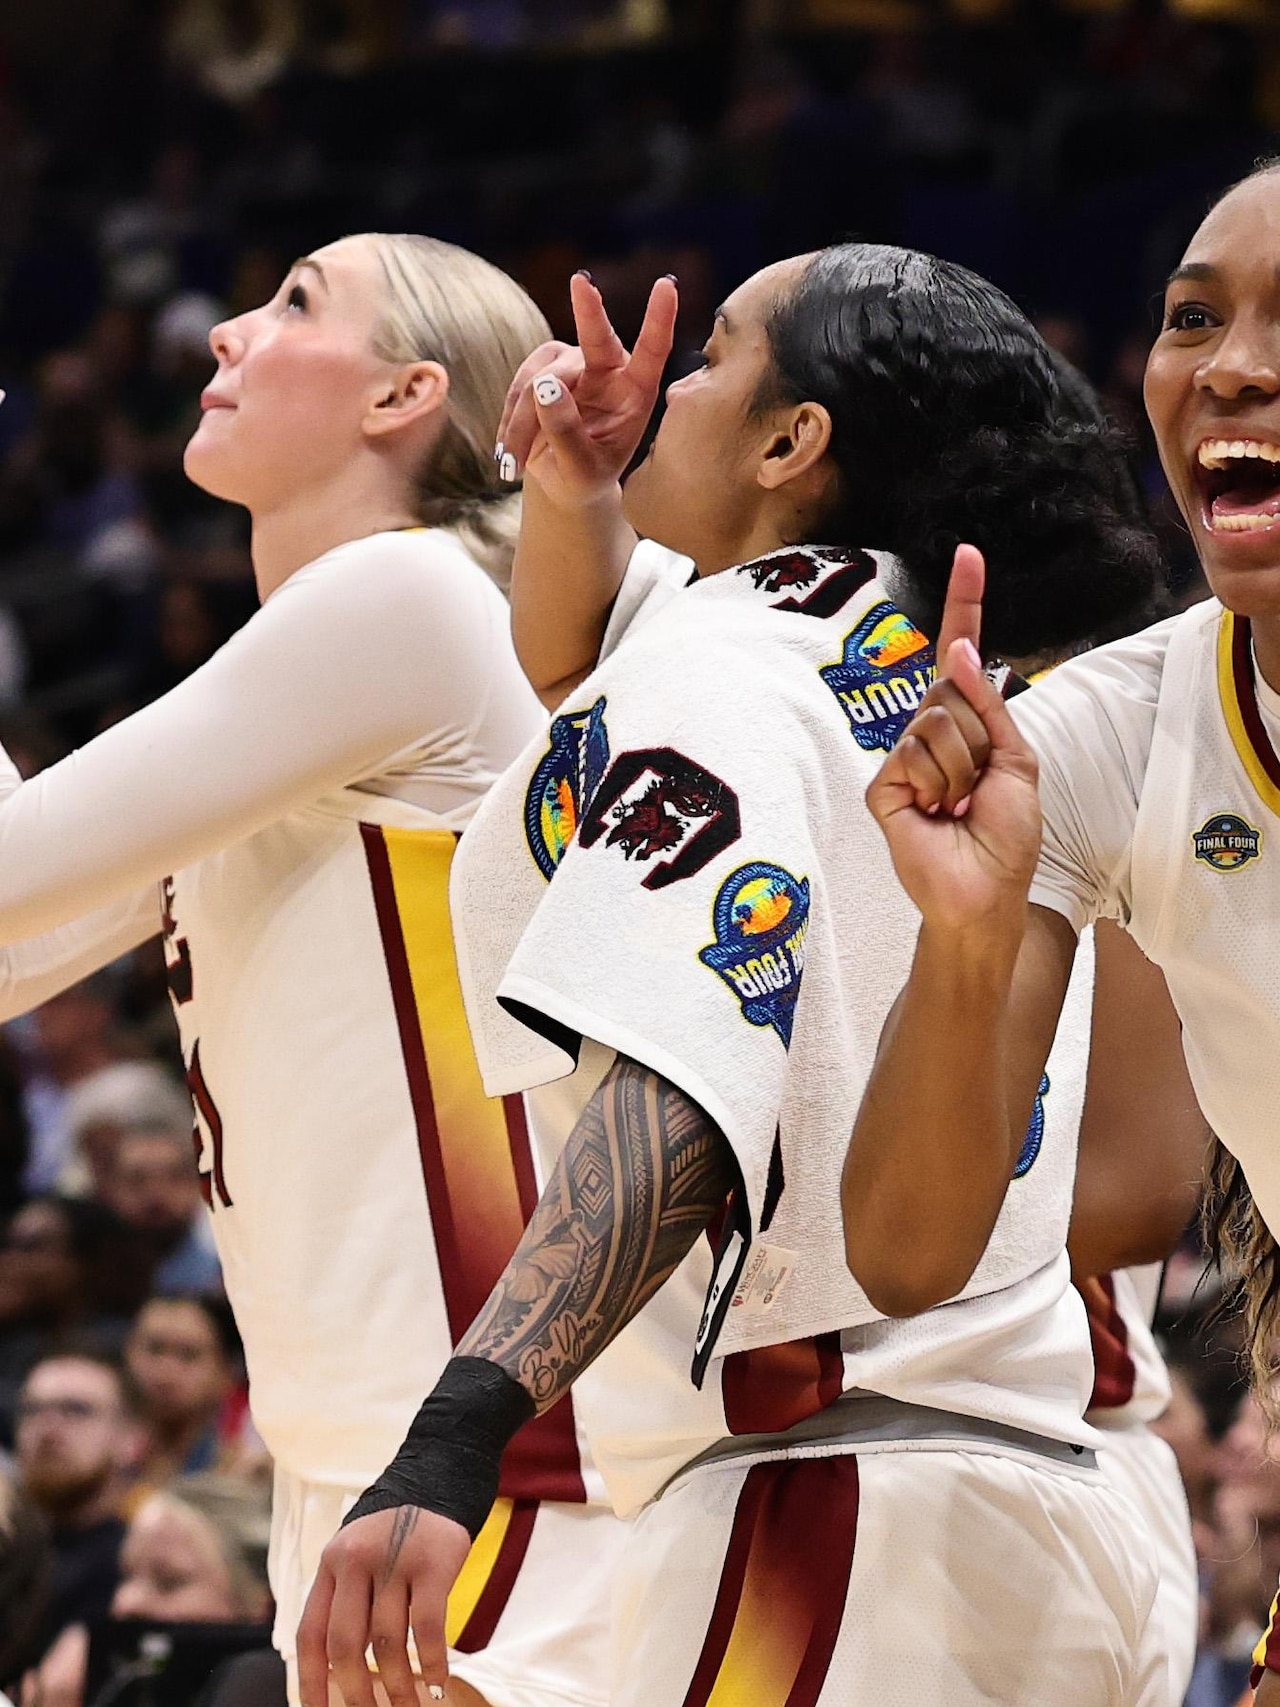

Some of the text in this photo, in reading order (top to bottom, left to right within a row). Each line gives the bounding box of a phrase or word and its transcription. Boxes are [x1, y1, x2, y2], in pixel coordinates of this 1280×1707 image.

[1197, 836, 1256, 851] FINAL FOUR
[723, 945, 792, 999] FOUR
